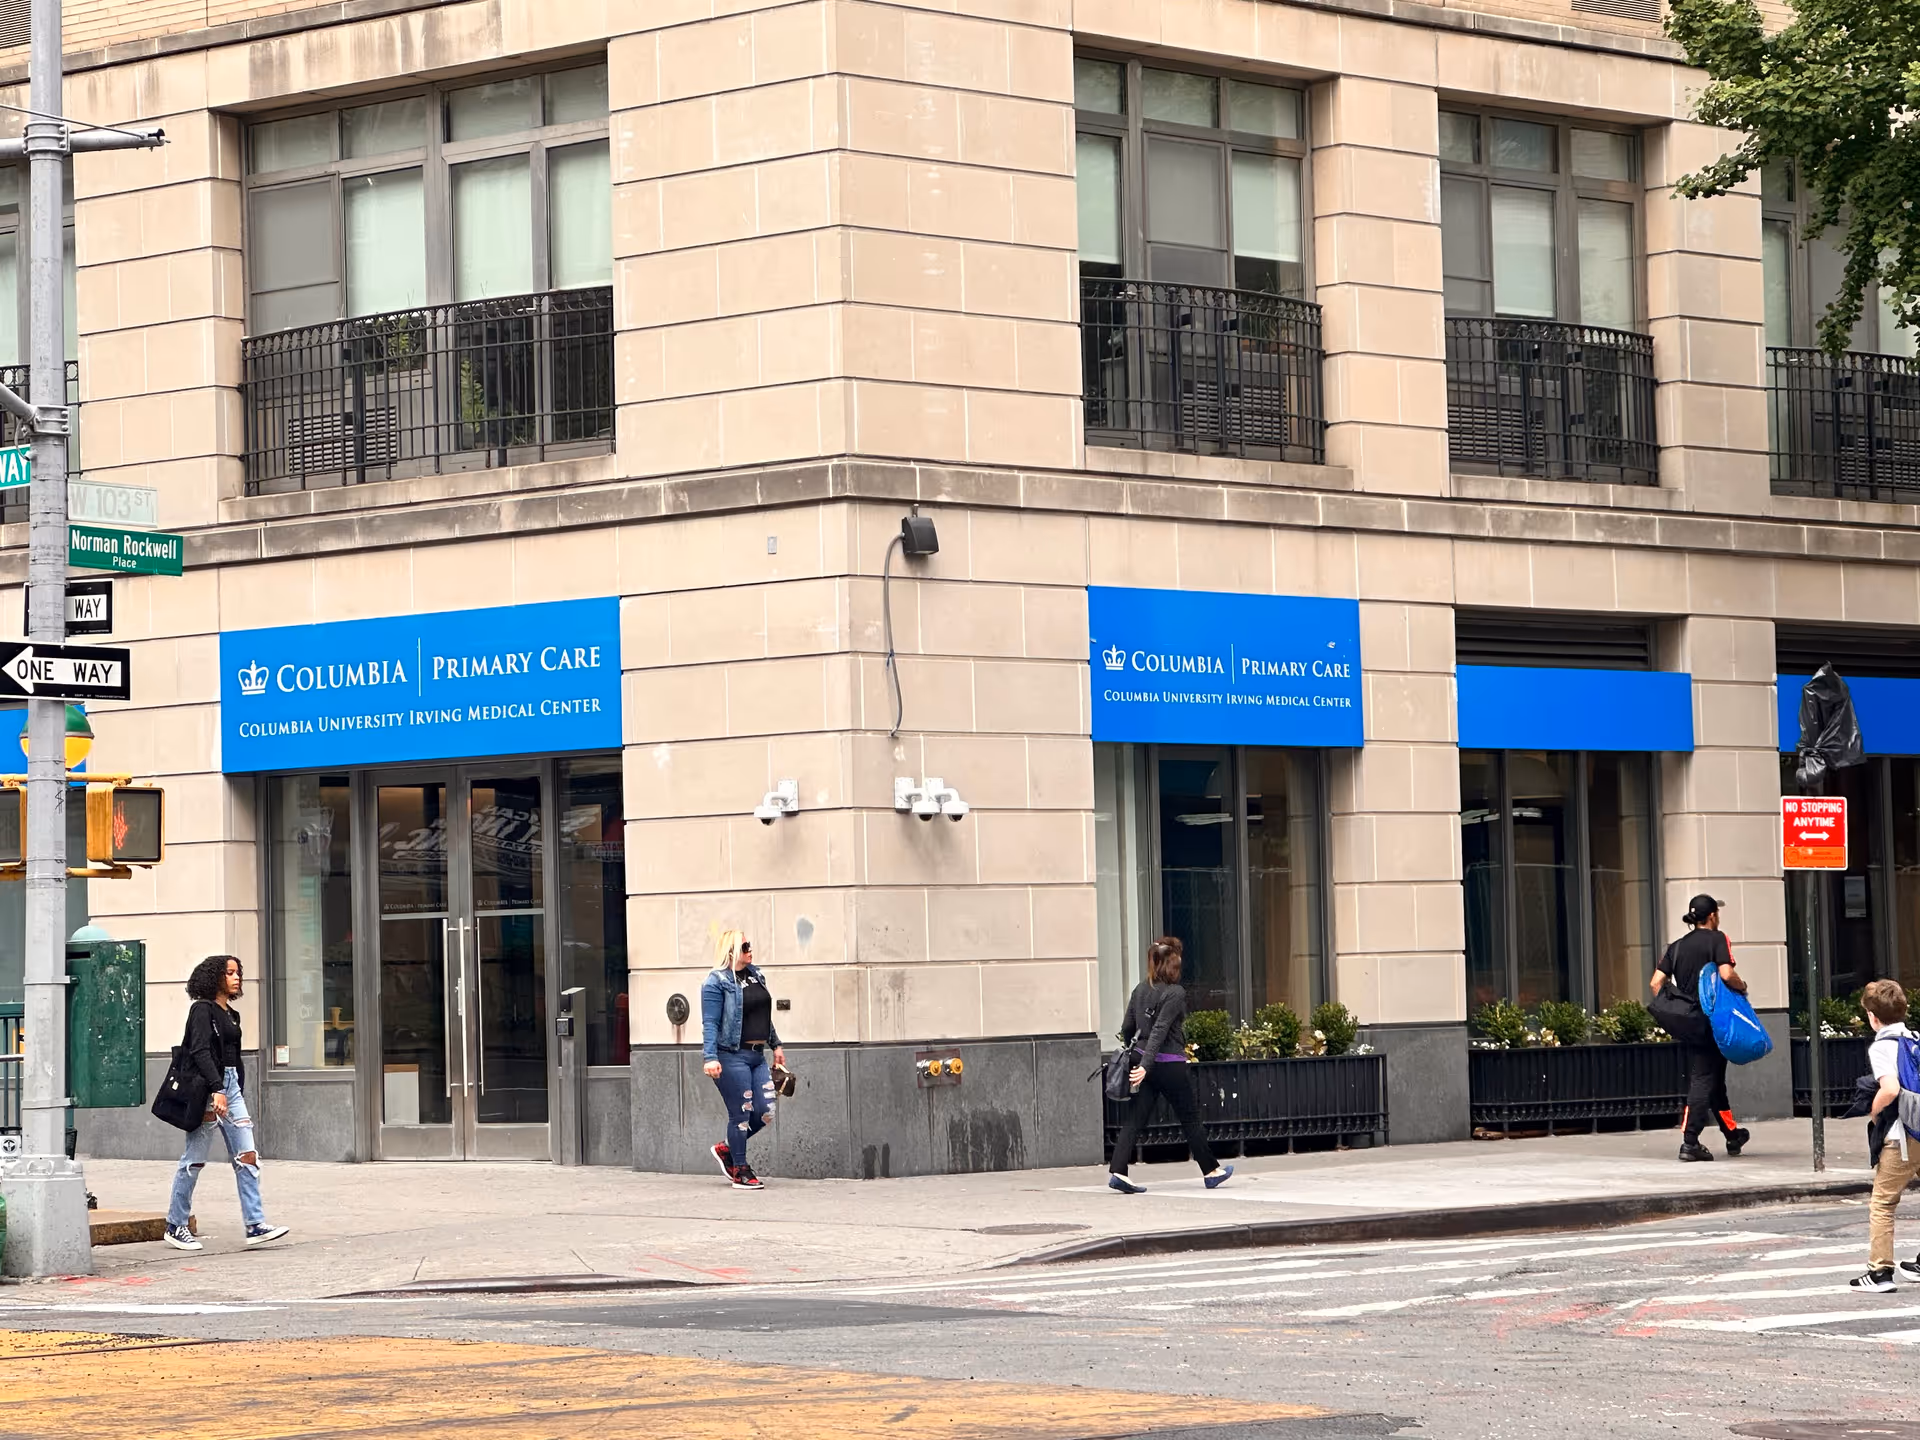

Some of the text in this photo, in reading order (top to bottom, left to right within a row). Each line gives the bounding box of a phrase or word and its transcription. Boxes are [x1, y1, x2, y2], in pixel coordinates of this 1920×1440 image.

[70, 486, 151, 519] W 103 ST
[71, 529, 177, 559] Norman Rockwell
[113, 556, 137, 568] Place
[74, 598, 101, 618] WAY
[17, 660, 113, 683] ONE WAY
[276, 646, 600, 693] COLUMBIA PRIMARY CARE
[1131, 651, 1350, 678] COLUMBIA PRIMARY CARE
[1104, 690, 1351, 708] COLUMBIA UNIVERSITY IRVING MEDICAL CENTER
[239, 698, 601, 738] COLUMBIA UNIVERSITY IRVING MEDICAL CENTER
[1785, 802, 1842, 813] NO STOPPING
[1793, 817, 1835, 827] ANYTIME
